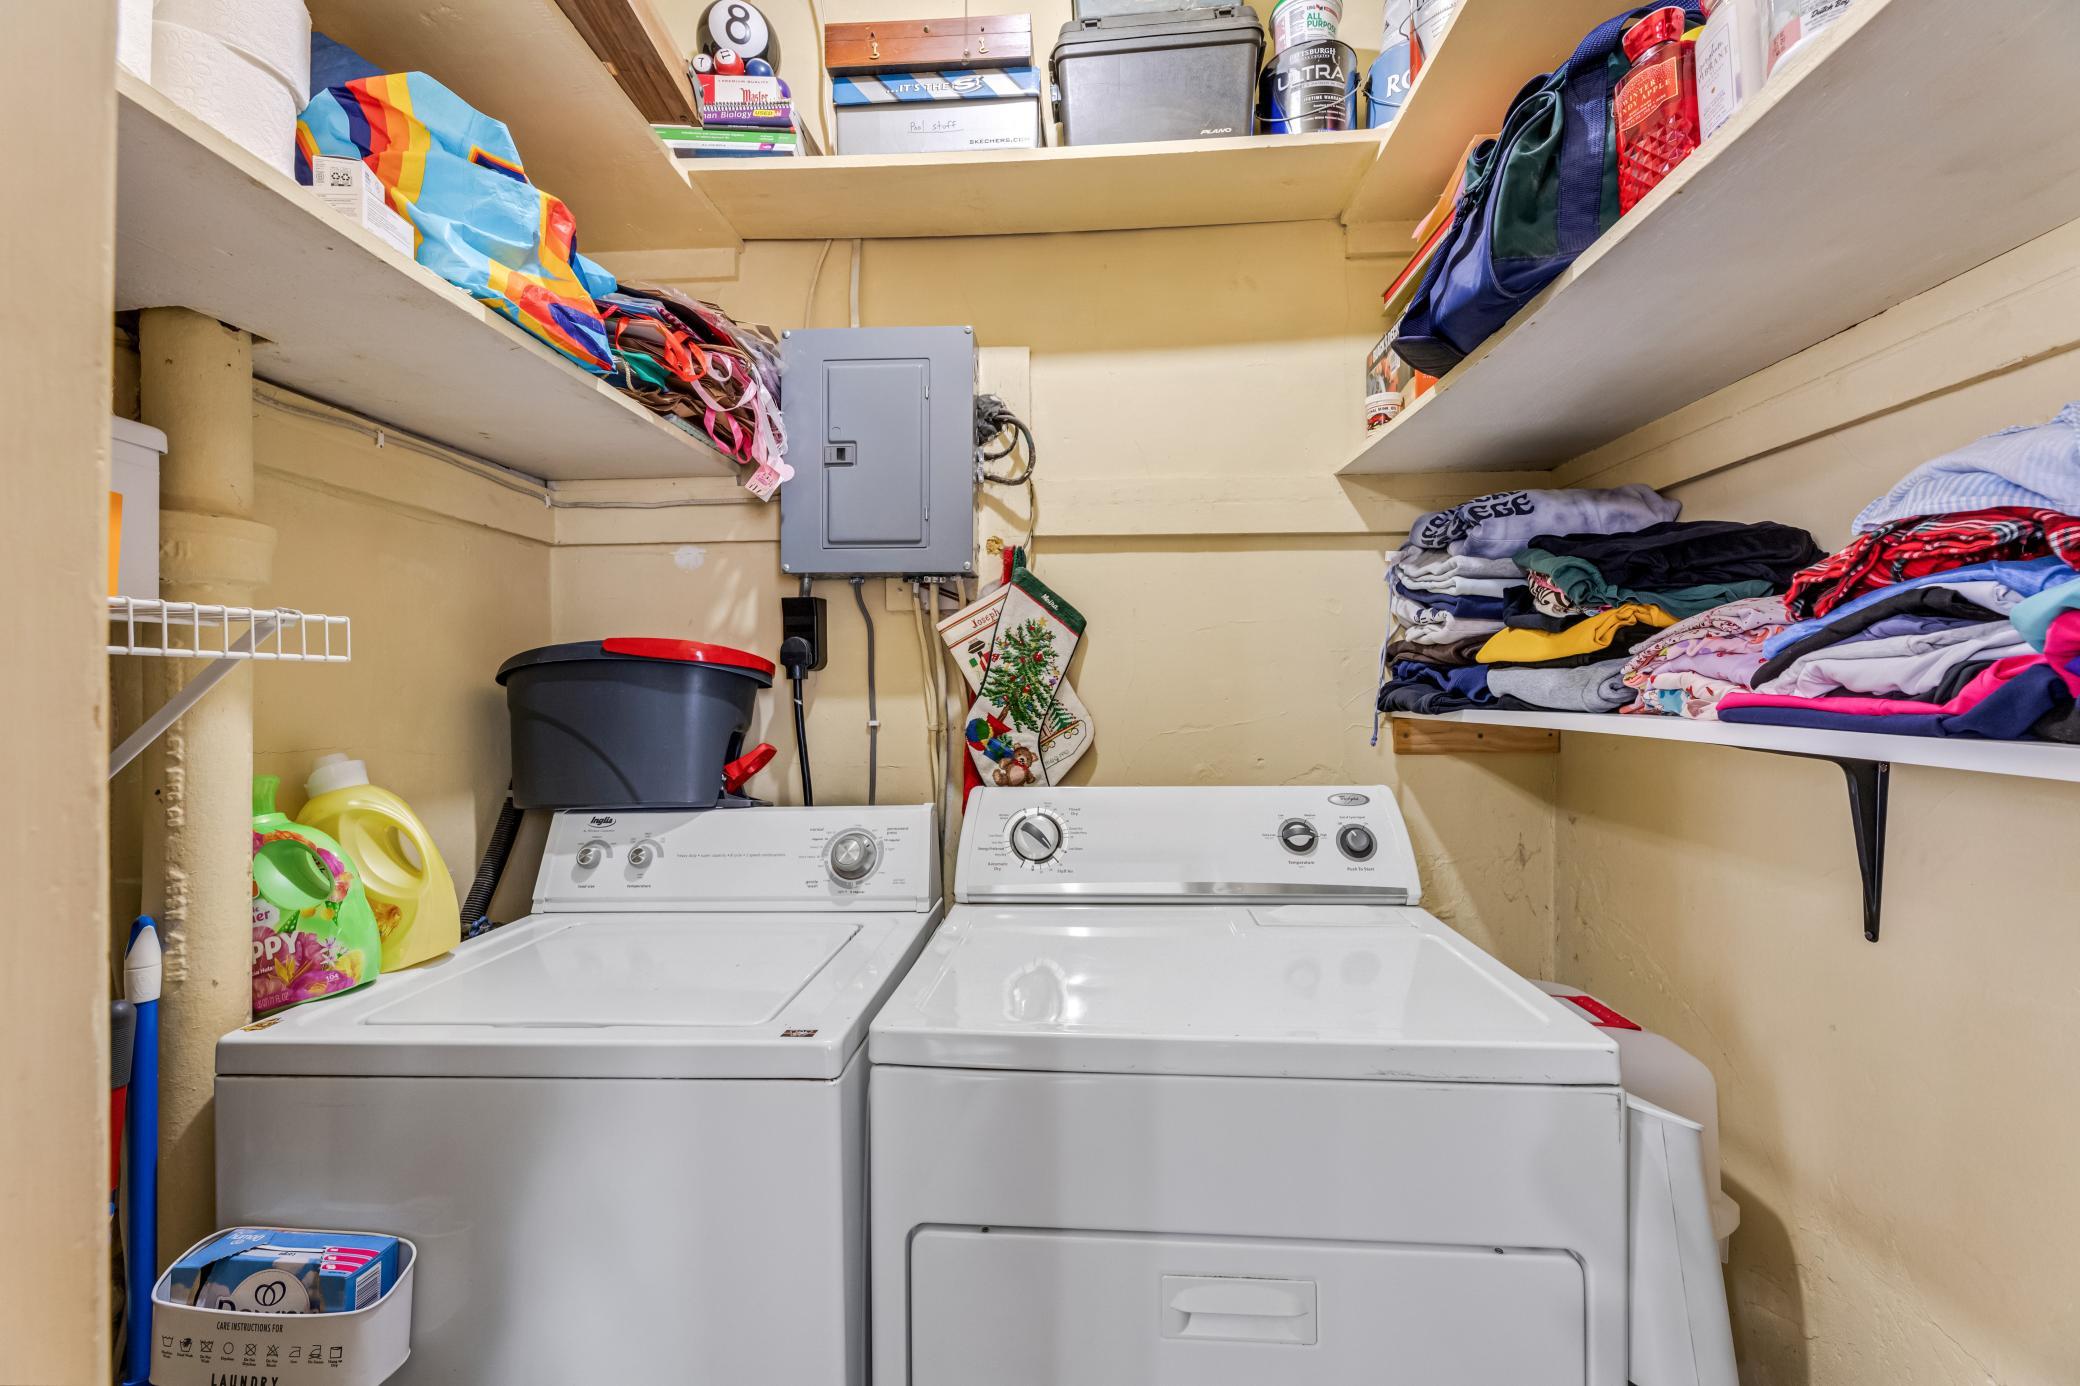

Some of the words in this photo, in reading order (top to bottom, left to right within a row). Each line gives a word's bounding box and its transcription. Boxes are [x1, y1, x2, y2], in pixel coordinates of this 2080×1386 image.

[1306, 12, 1322, 20] ALL
[1811, 4, 1833, 19] Dutch
[726, 4, 751, 45] 8
[1306, 20, 1337, 34] PURPOSE
[698, 57, 704, 68] 7
[923, 82, 949, 92] THE
[1622, 79, 1656, 106] WINTER
[1642, 79, 1671, 101] APPLE
[741, 87, 769, 104] Master
[721, 110, 752, 120] Biology
[910, 119, 925, 132] Pool
[1200, 127, 1232, 135] PLANO
[971, 607, 1000, 629] Joseph
[590, 816, 613, 826] Inglis
[216, 1321, 231, 1331] CARE
[231, 1322, 271, 1333] INSTRUCTIONS
[272, 1323, 284, 1334] FOR
[211, 1372, 279, 1386] LAUNDRY
